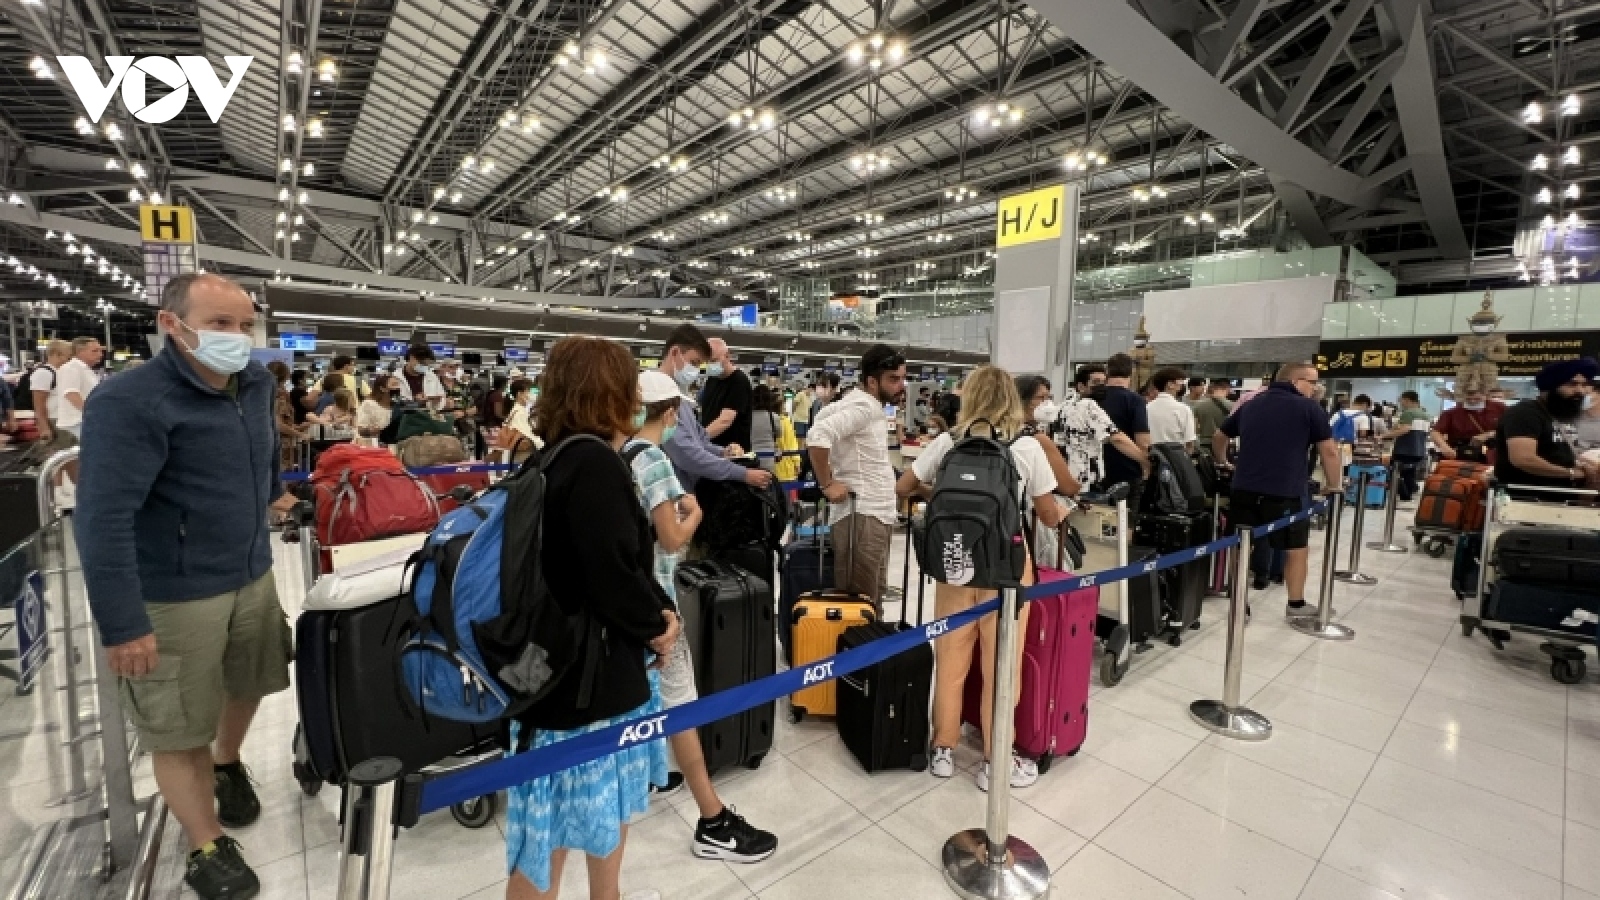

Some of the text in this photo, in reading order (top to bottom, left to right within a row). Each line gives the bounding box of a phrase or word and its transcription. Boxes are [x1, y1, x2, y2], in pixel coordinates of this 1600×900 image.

[151, 209, 180, 239] H
[1002, 198, 1058, 237] H/J
[925, 619, 949, 638] AOT
[803, 660, 835, 685] AOT
[618, 714, 669, 747] AOT
